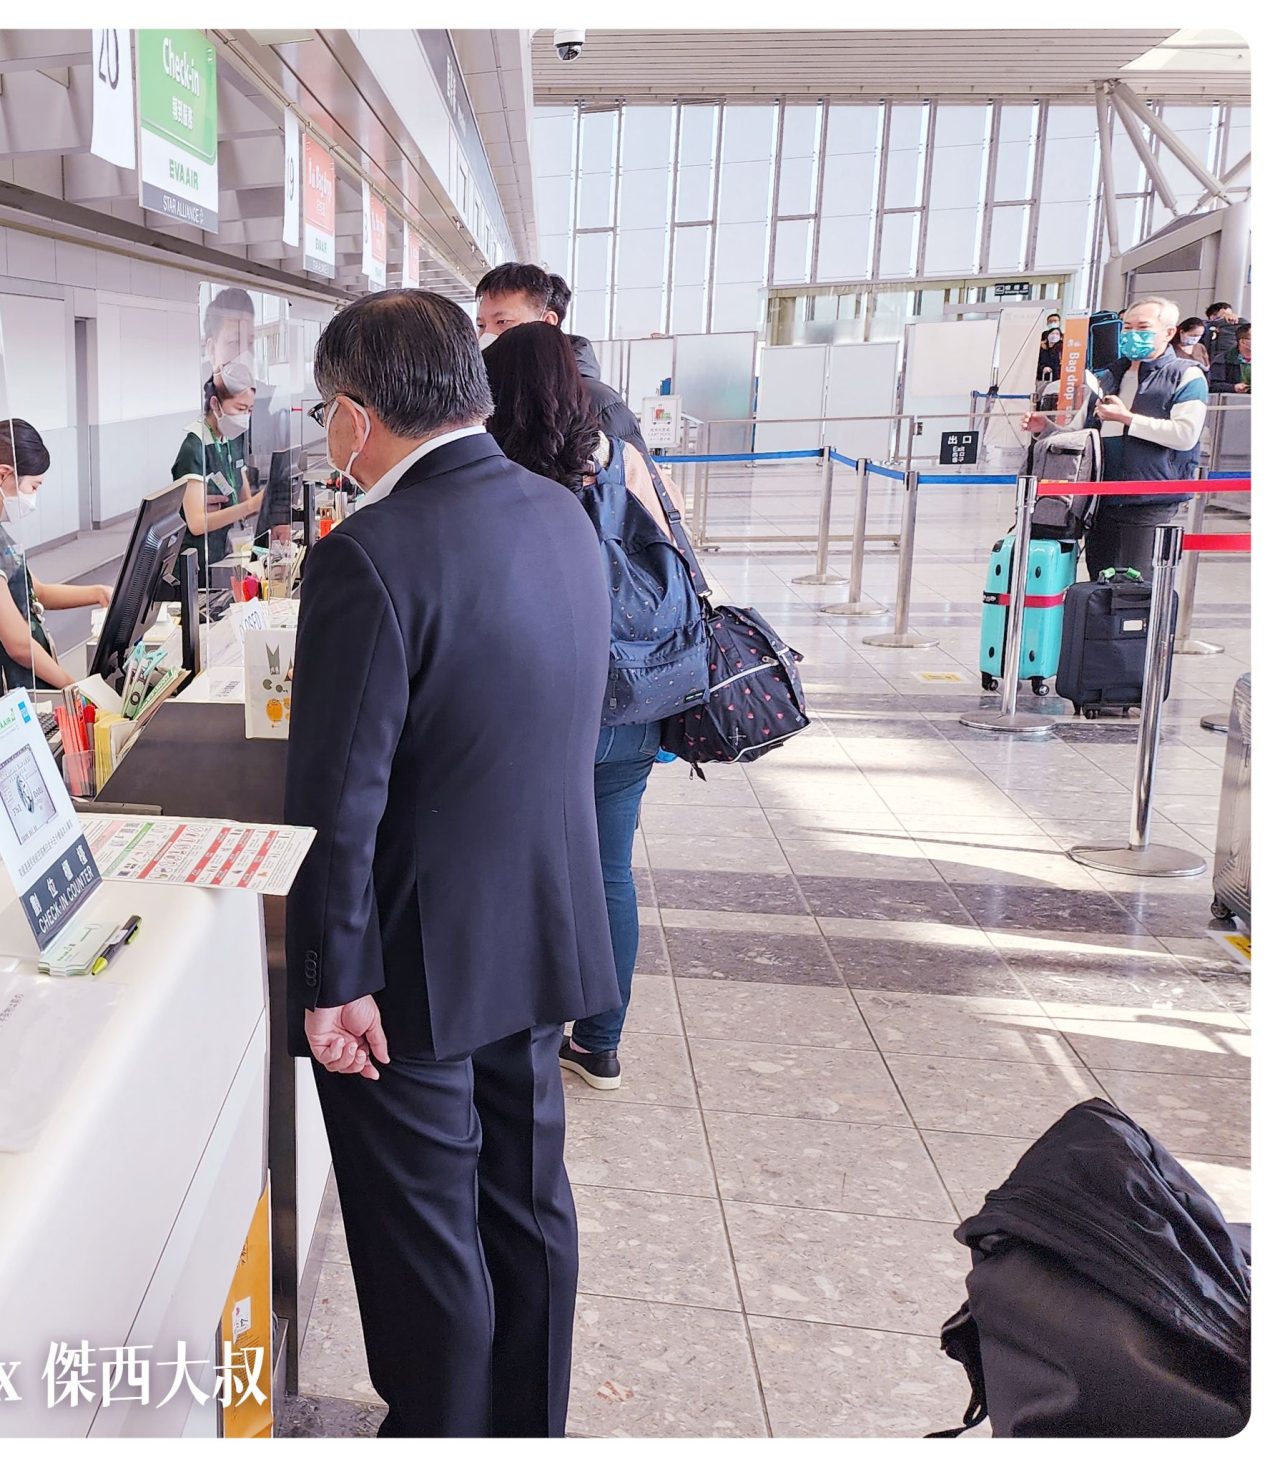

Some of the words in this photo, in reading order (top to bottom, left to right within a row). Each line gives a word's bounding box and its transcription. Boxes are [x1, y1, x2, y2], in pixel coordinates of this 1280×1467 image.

[163, 37, 200, 96] Check-in
[1065, 352, 1080, 373] Bag
[1063, 374, 1077, 400] drop
[948, 435, 972, 445] 出口
[38, 891, 69, 934] CHECK-IN
[66, 866, 95, 905] COUNTER
